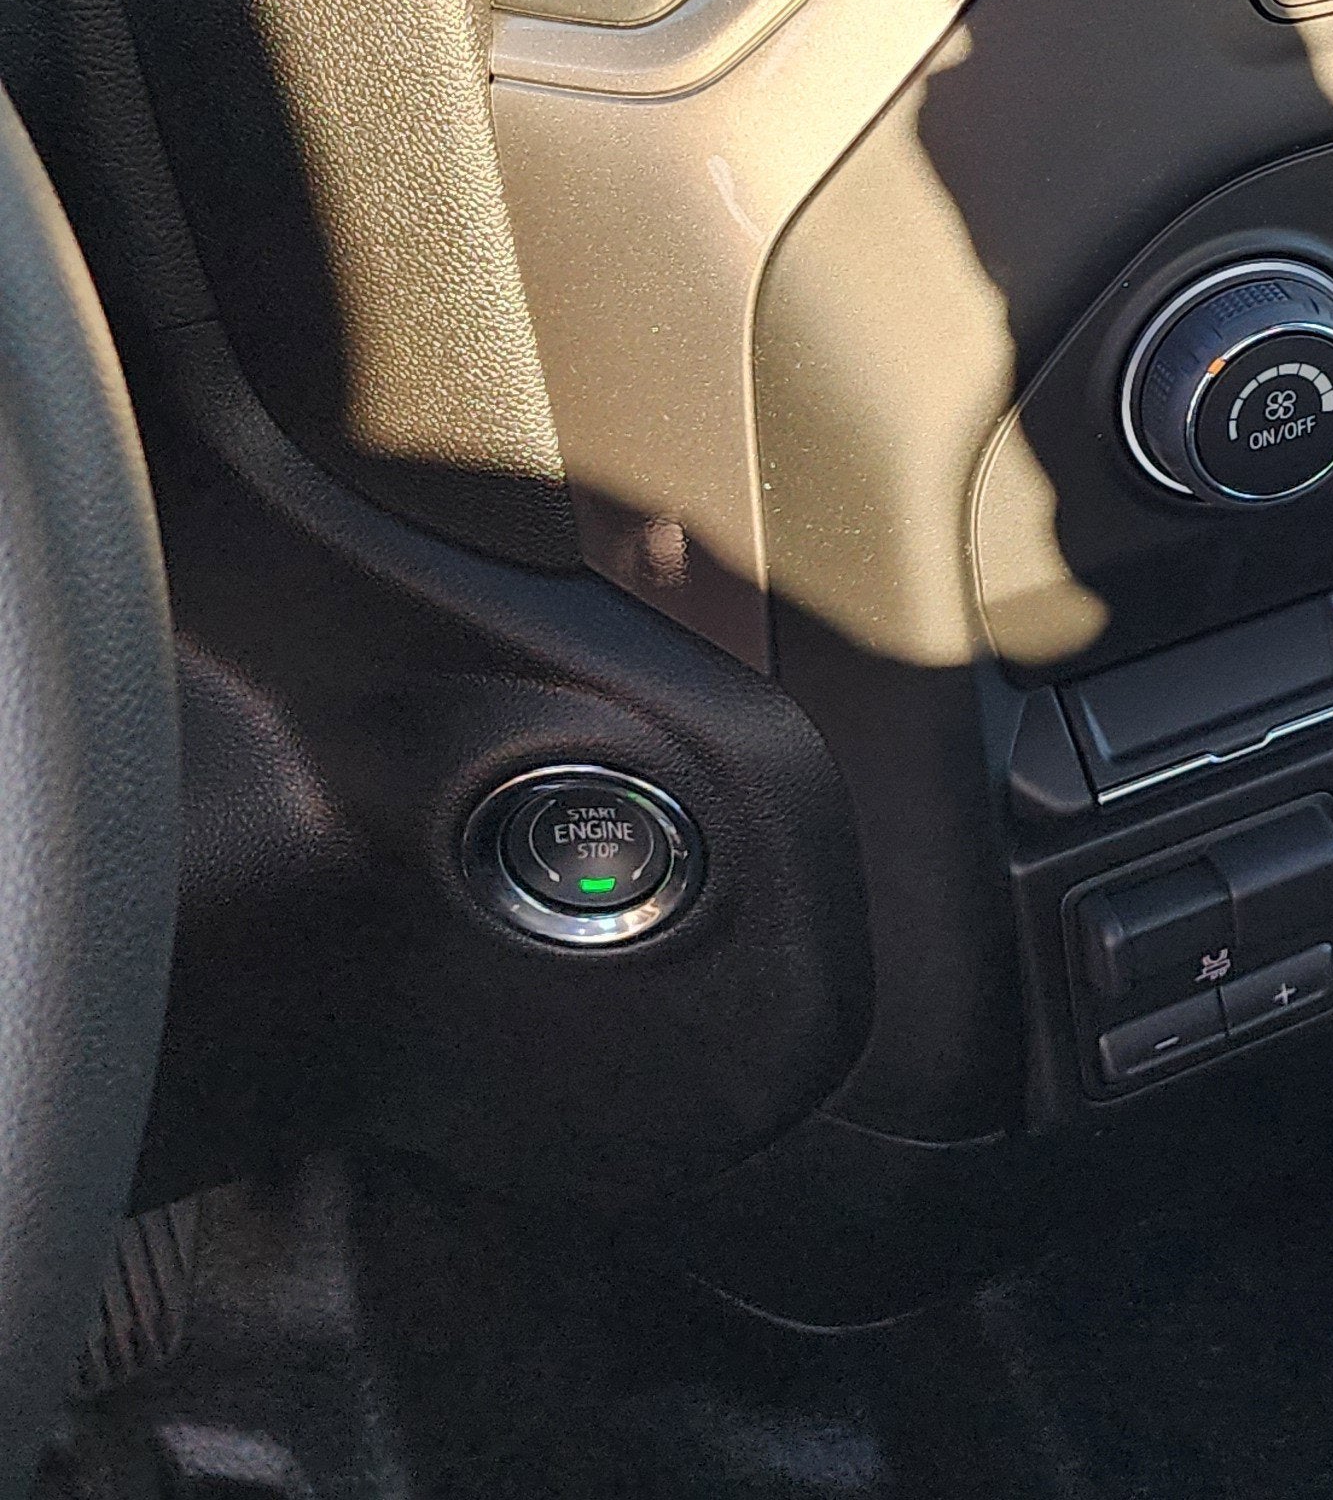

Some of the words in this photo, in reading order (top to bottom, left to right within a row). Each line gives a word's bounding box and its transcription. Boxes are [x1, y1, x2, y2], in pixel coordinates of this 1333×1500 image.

[1249, 414, 1317, 450] ON/OFF
[566, 806, 617, 820] START
[554, 820, 635, 845] ENGINE
[577, 842, 619, 860] STOP
